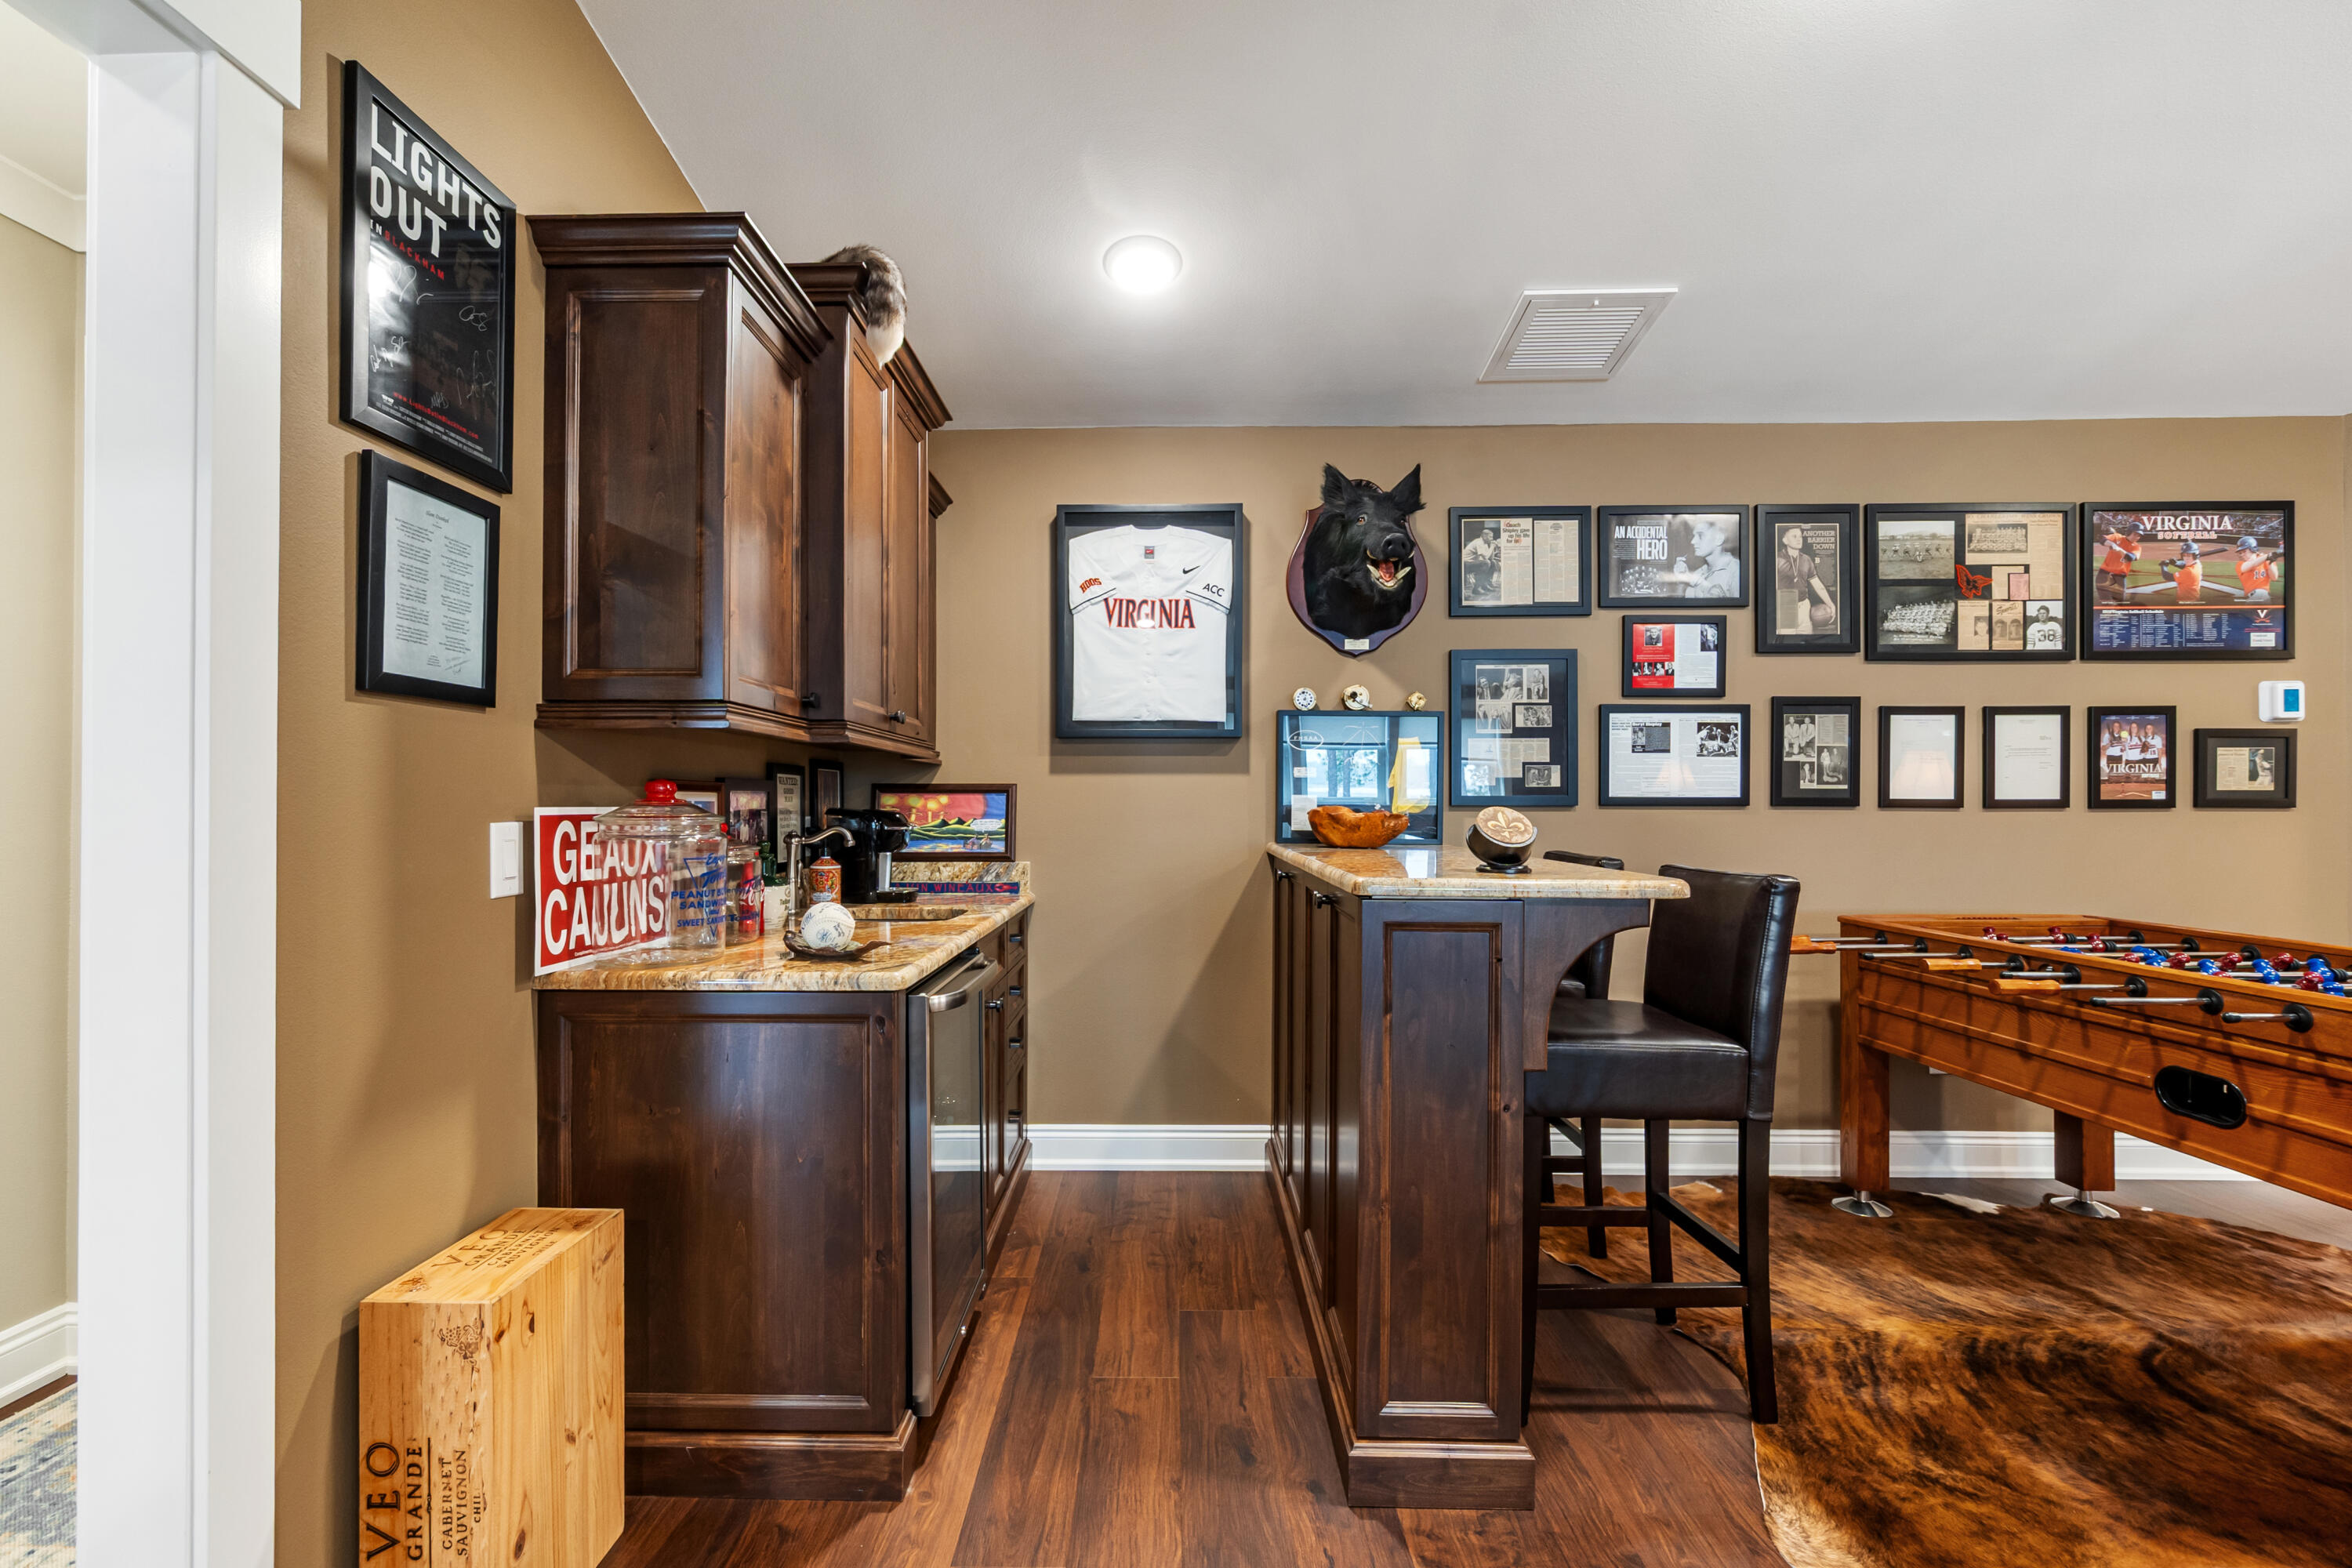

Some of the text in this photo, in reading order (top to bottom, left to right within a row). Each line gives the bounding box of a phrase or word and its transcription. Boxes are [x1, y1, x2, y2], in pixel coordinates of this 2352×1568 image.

[372, 103, 502, 249] LIGHTS
[370, 165, 447, 258] OUT
[370, 220, 445, 281] IN BLACKHAM
[1614, 526, 1668, 539] AN ACCIDENTAL
[2141, 515, 2234, 530] VIRGINIA
[1636, 539, 1668, 560] HERO
[1079, 577, 1102, 593] HOOS
[1203, 583, 1225, 597] ACC
[1103, 597, 1196, 629] VIRGINIA
[2106, 764, 2162, 773] VIRGINIA
[553, 820, 658, 885] GEAUX
[671, 889, 716, 899] PEANUT
[934, 883, 993, 892] WINEAUX
[544, 876, 665, 955] CAJUNS
[677, 919, 704, 927] SWEET
[366, 1442, 401, 1562] VEO
[407, 1447, 423, 1561] GRANDE
[441, 1458, 452, 1550] CABERNET
[456, 1450, 468, 1556] SAUVIGNON
